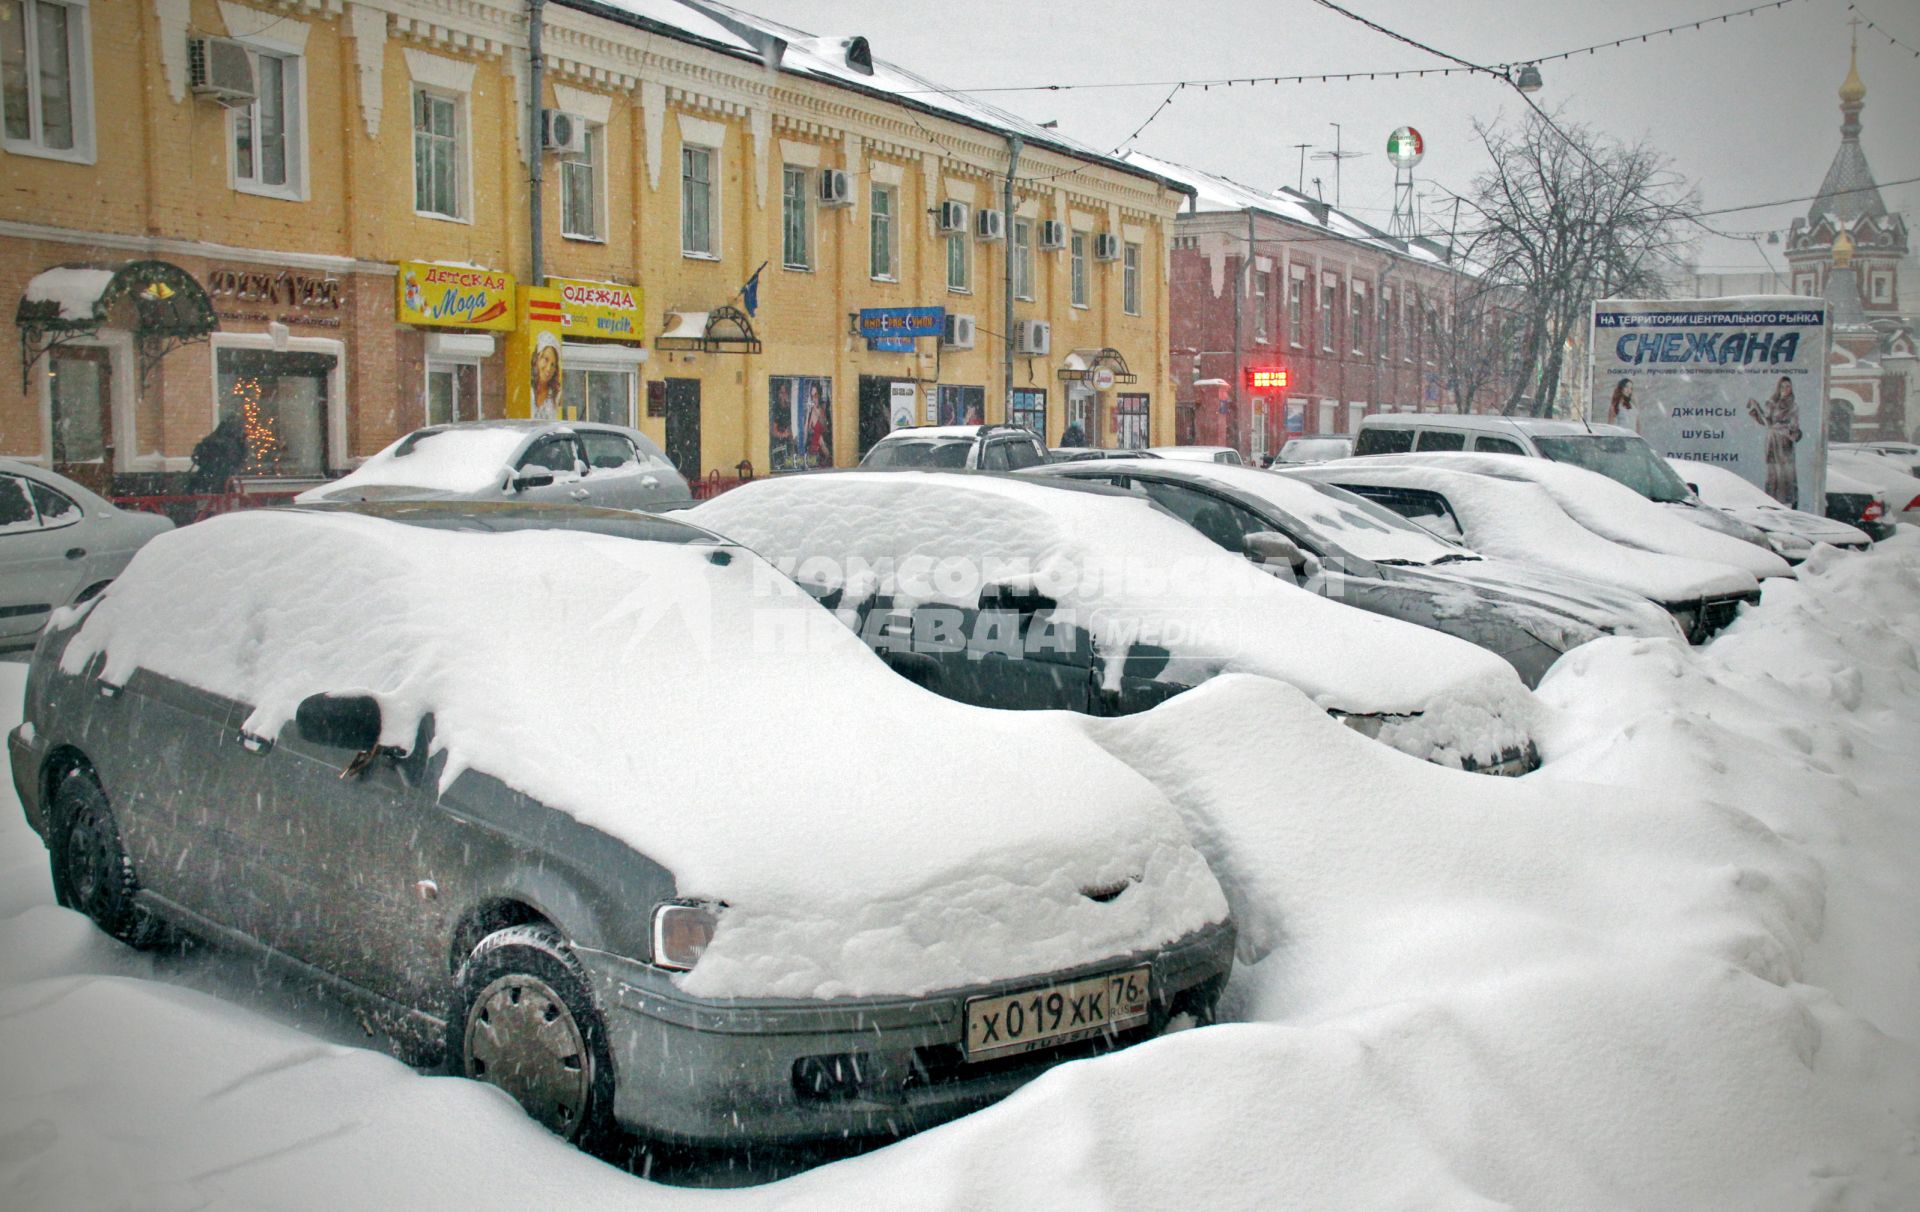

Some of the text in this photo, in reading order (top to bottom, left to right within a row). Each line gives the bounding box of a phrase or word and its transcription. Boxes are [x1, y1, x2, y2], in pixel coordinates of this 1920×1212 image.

[425, 268, 506, 291] ДЕТСКАЯ
[433, 287, 487, 320] Мода
[563, 286, 634, 308] ОДЕЖДА
[1600, 312, 1819, 326] НА ТЕРРИТОРИИ ЦЕНТРАЛЬНОГО РЫНКА
[1615, 332, 1801, 366] СНЕЖАНА
[1672, 406, 1737, 418] ДЖИНСЫ
[1682, 429, 1725, 440] ШУБЫ
[1111, 974, 1138, 1005] 76
[1110, 1004, 1131, 1018] RUS
[1024, 1027, 1105, 1051] RUSSIA
